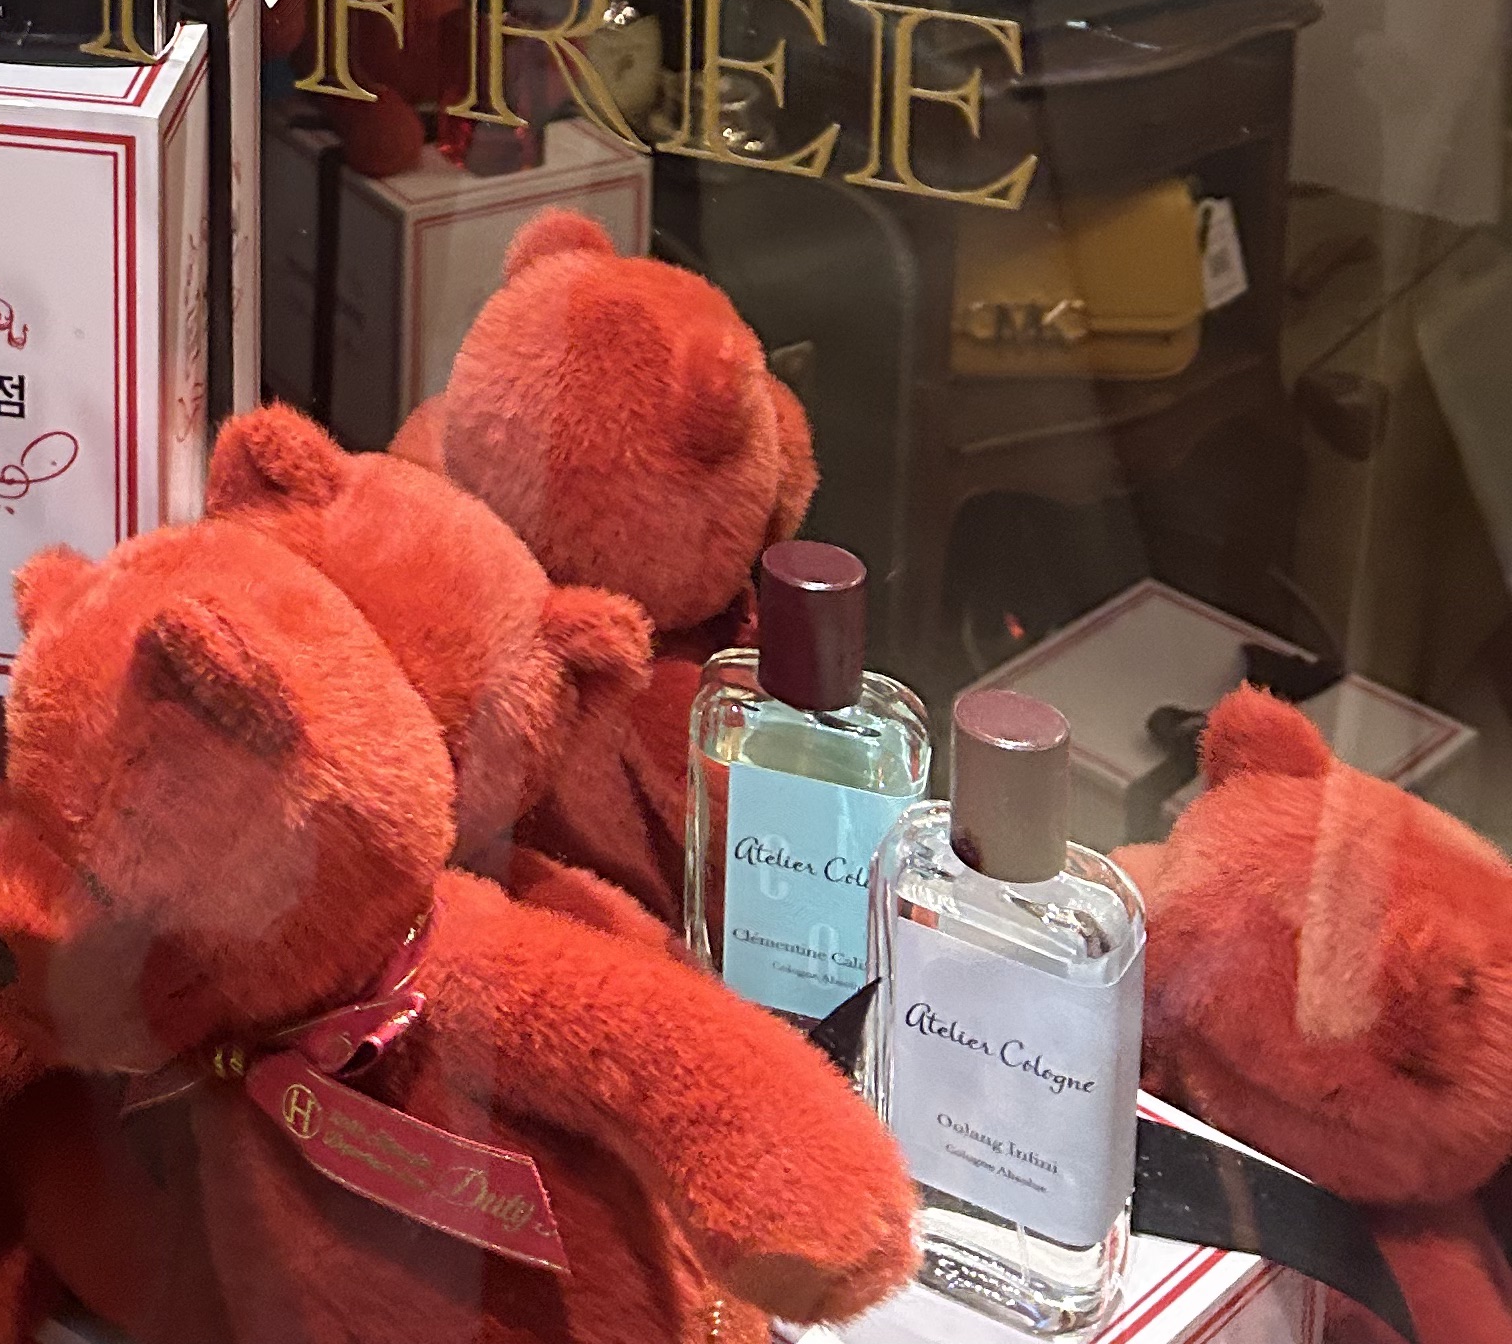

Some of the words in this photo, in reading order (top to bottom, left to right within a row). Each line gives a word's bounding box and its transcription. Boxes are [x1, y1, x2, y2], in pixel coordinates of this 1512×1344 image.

[734, 836, 818, 876] Atelier
[732, 927, 828, 962] Clémentine
[905, 1002, 994, 1056] Atelier
[1000, 1039, 1096, 1094] Cologne
